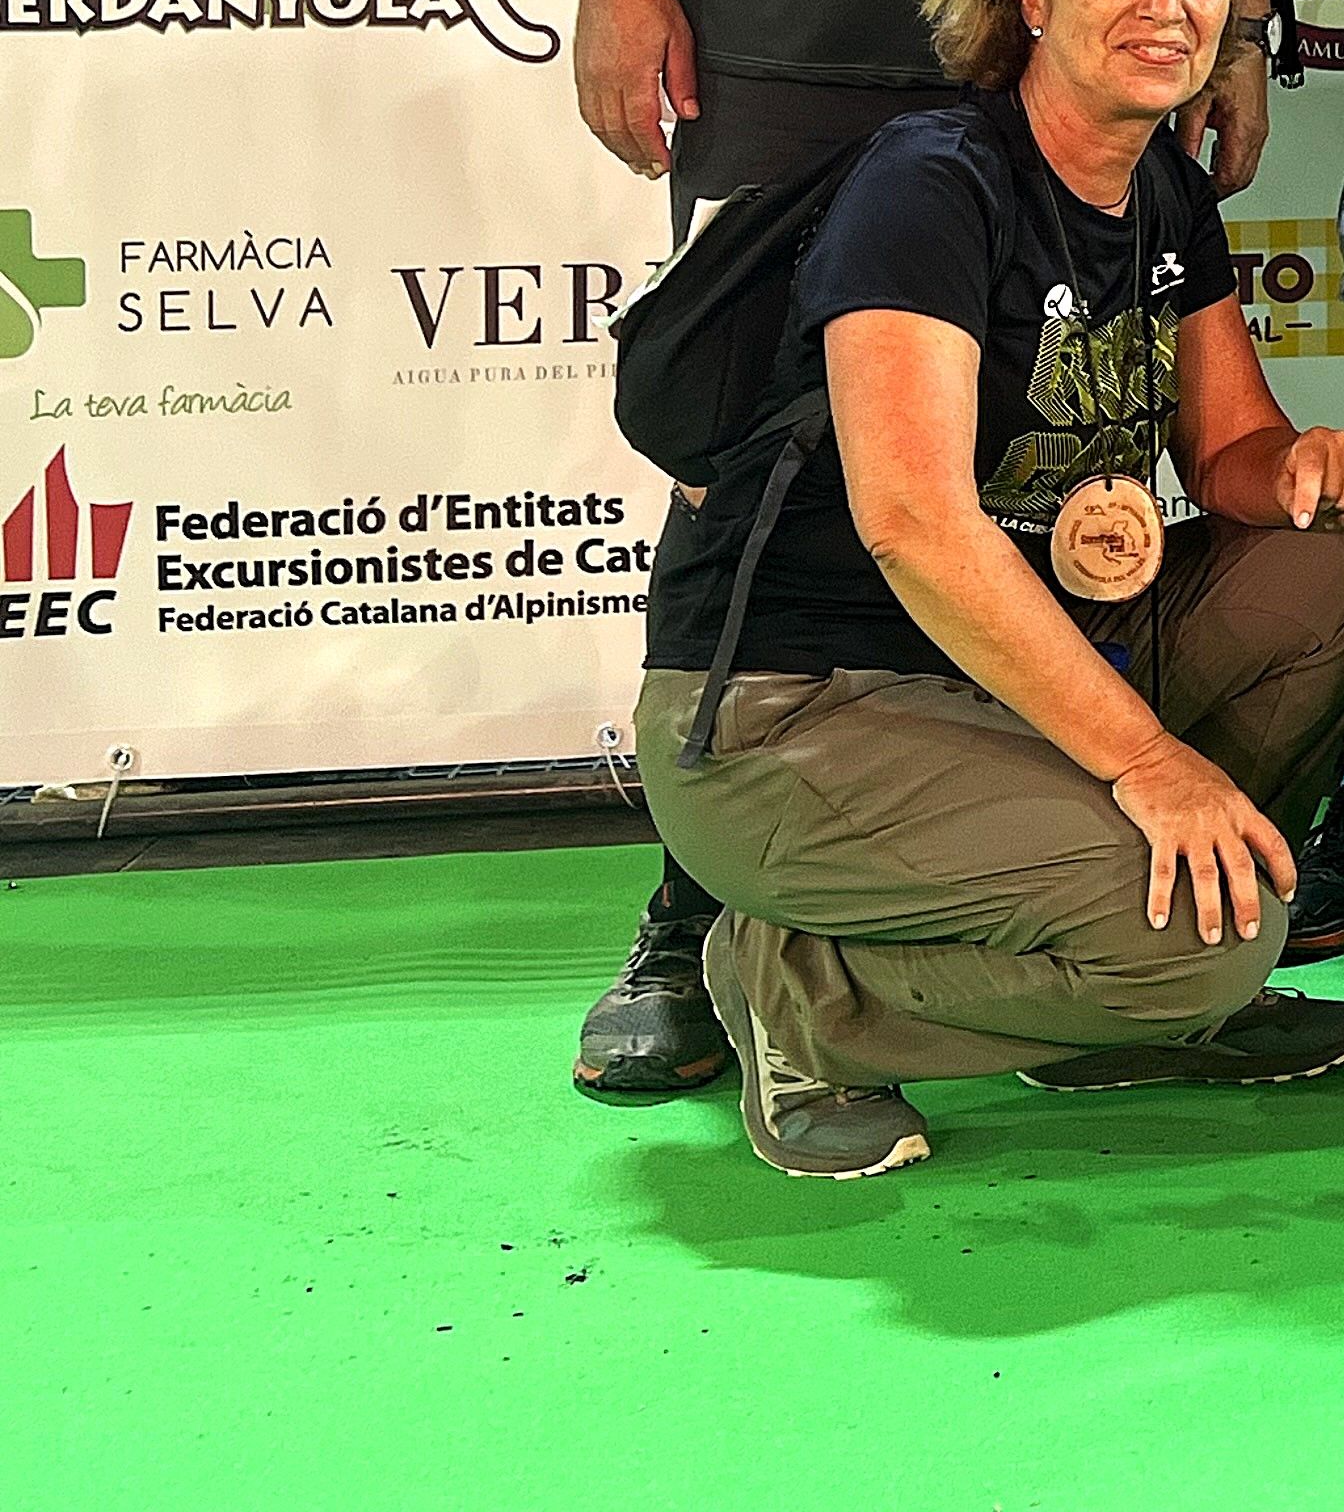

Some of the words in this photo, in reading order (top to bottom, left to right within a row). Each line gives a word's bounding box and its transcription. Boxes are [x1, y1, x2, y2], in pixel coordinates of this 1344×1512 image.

[119, 230, 333, 274] FARMÀCIA
[117, 286, 334, 333] SELVA
[392, 367, 462, 385] AIGUA
[470, 366, 526, 383] PURA
[535, 364, 579, 381] DEL
[28, 388, 73, 421] La
[84, 391, 149, 419] teva
[157, 385, 293, 416] farmàcia
[155, 496, 385, 542] Federació
[398, 492, 625, 533] d'Entitats
[157, 541, 493, 592] Excursionistes
[504, 539, 564, 578] de
[576, 537, 656, 575] Cat
[158, 600, 314, 633] Federació
[320, 596, 457, 627] Catalana
